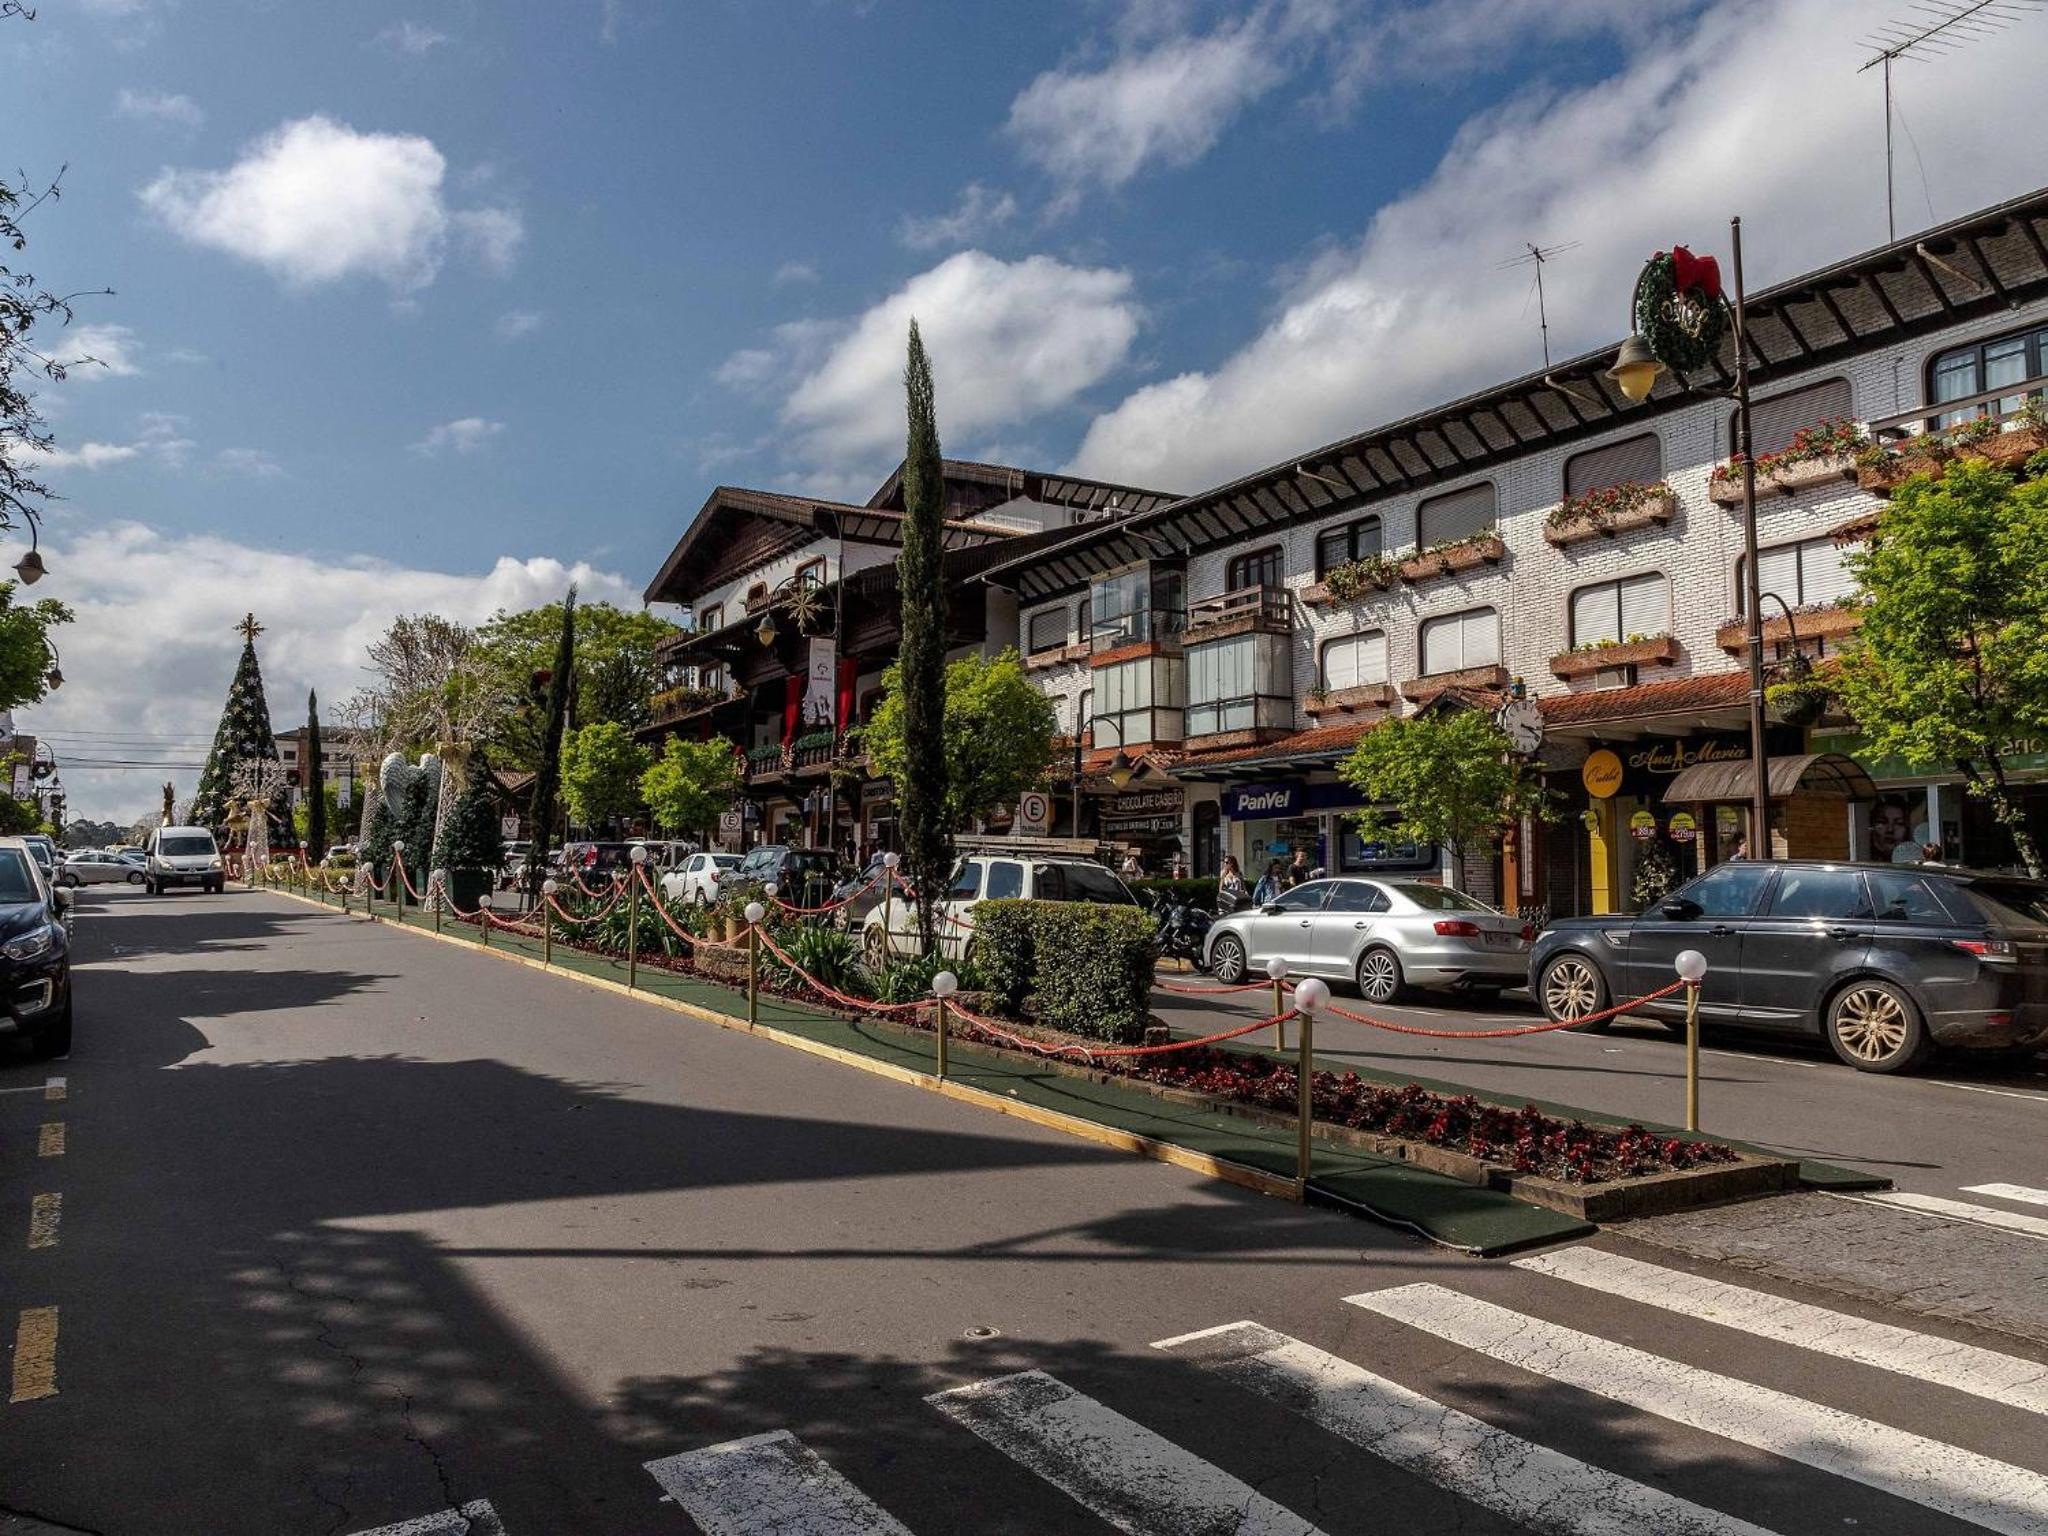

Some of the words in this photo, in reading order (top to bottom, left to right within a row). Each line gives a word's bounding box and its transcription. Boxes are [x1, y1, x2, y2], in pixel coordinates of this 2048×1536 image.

[1684, 740, 1747, 764] Maria
[1117, 794, 1154, 810] CHOCOLATE
[1237, 790, 1291, 811] PanVel
[1030, 802, 1039, 816] E
[728, 816, 735, 825] E
